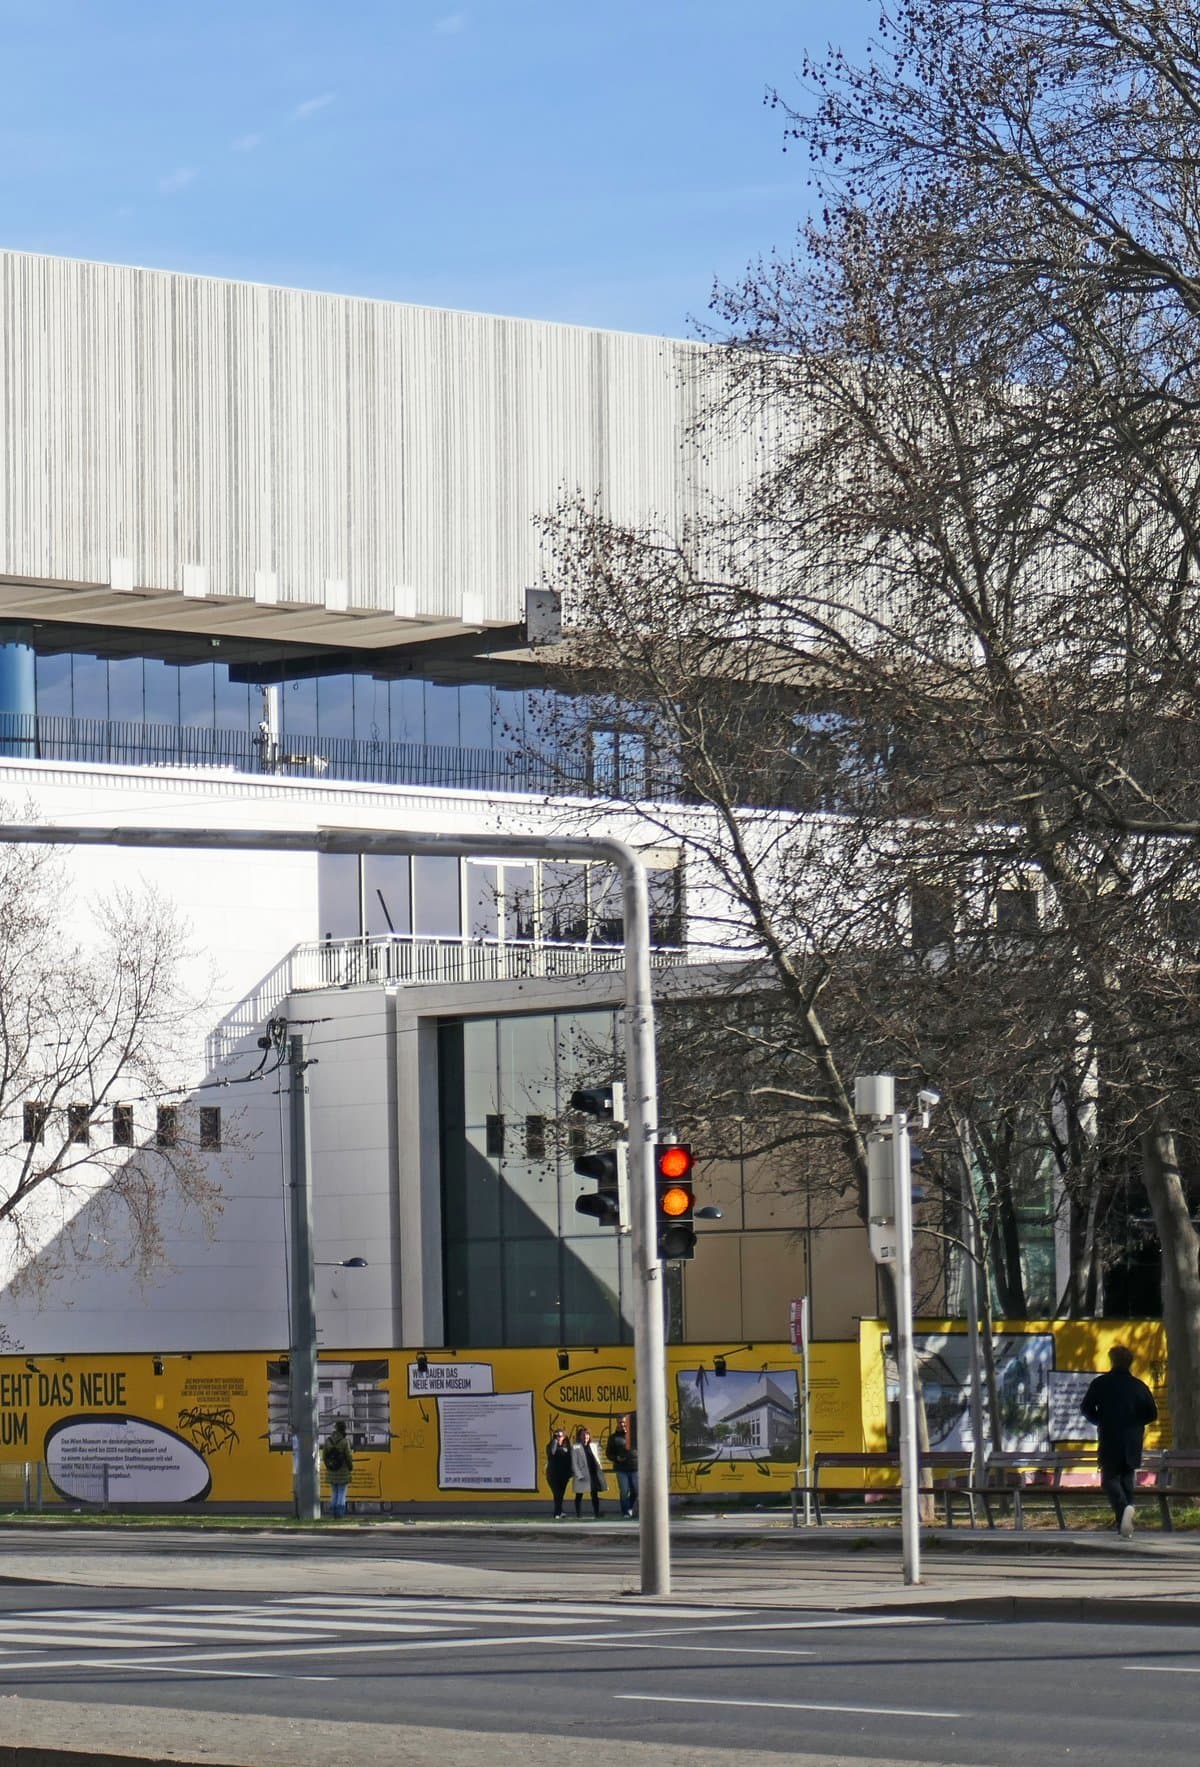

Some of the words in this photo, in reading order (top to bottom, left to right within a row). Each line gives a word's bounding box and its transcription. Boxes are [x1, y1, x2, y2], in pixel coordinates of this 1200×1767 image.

[446, 1367, 458, 1378] DAS
[39, 1373, 74, 1407] DAS
[80, 1372, 127, 1406] NEUE
[412, 1379, 429, 1390] NEUE
[429, 1379, 445, 1390] WIEN
[445, 1378, 472, 1390] MUSEUM
[560, 1385, 594, 1402] SCHAU.
[597, 1385, 631, 1402] SCHAU.
